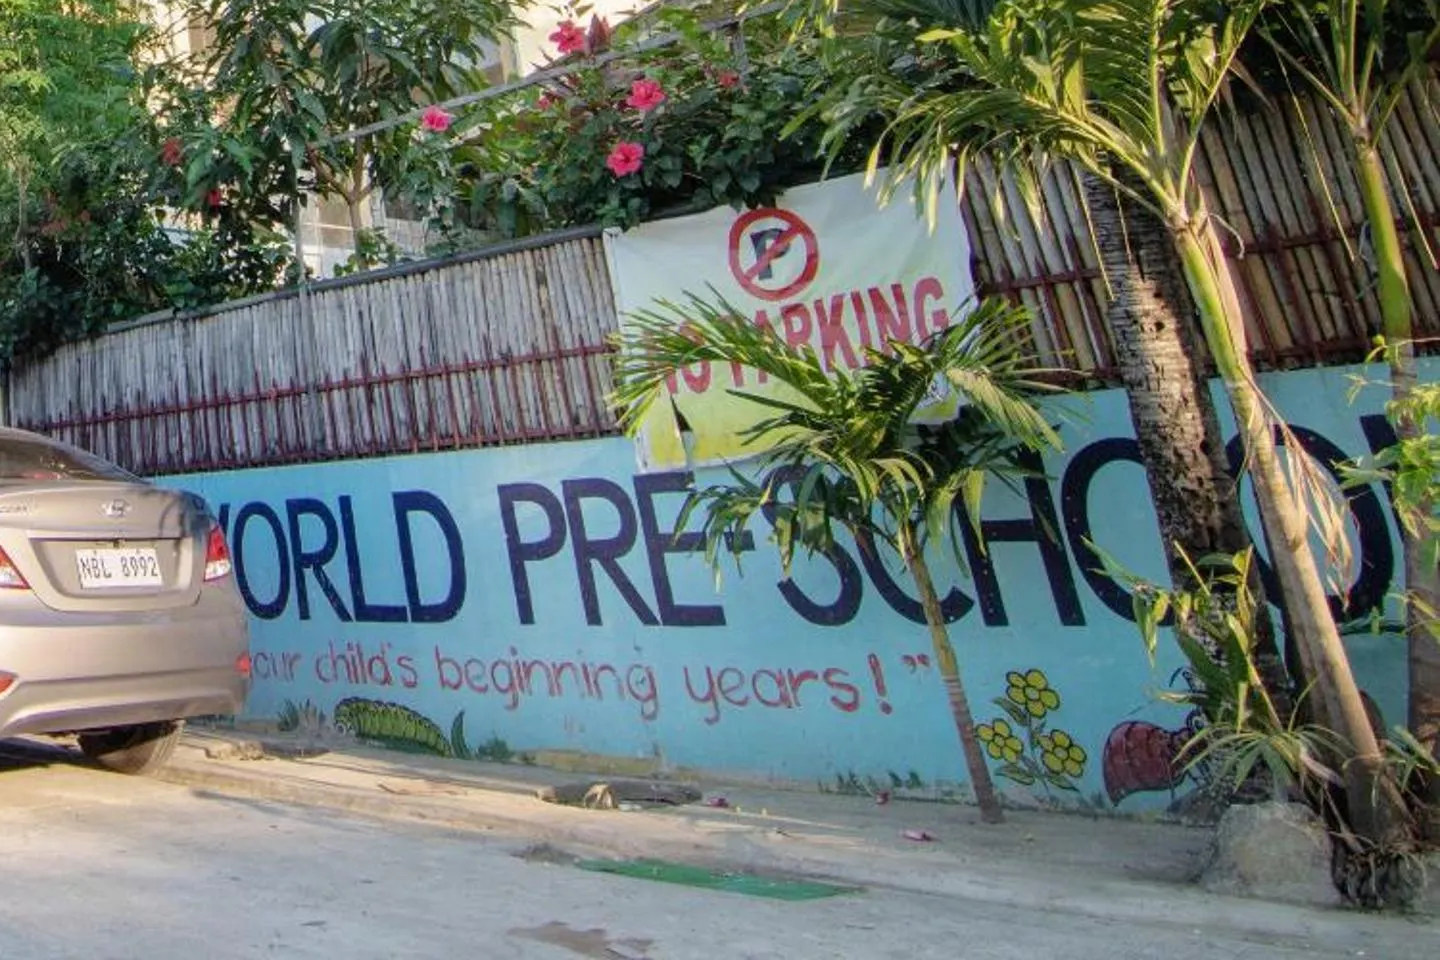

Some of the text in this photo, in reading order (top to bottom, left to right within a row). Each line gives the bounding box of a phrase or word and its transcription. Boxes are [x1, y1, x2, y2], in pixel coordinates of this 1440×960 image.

[79, 557, 112, 579] NBL
[215, 489, 467, 623] ORLD
[249, 649, 302, 684] our
[315, 640, 418, 689] child's
[434, 644, 659, 722] beginning
